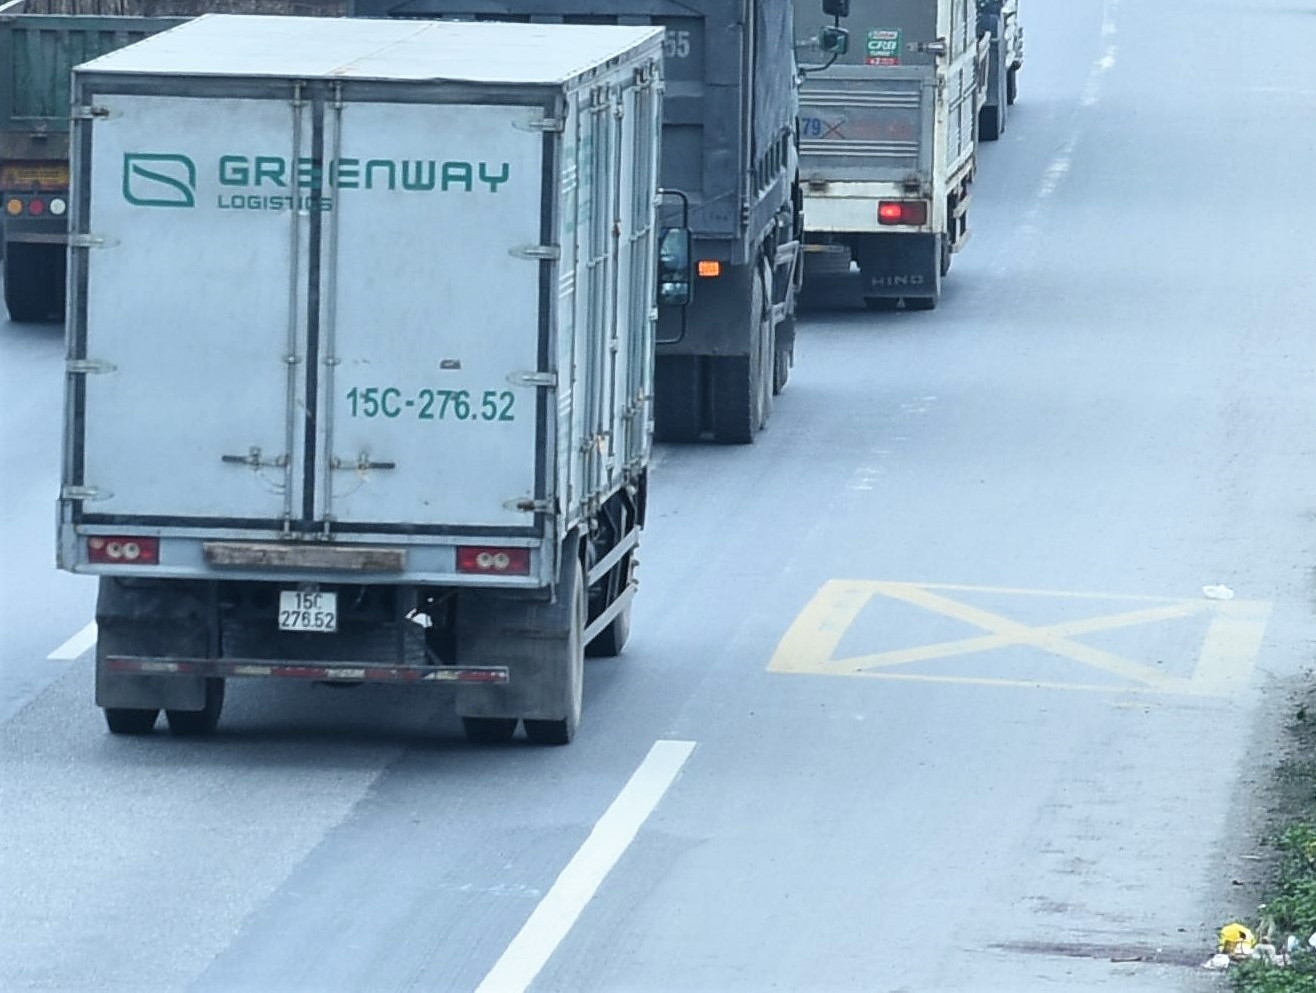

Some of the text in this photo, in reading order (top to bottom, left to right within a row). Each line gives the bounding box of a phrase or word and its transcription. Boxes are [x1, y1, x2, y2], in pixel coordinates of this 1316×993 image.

[218, 155, 510, 193] GREENWAY
[217, 194, 334, 213] LOGISTICS
[871, 274, 924, 287] HINO
[346, 386, 515, 422] 15C-276.52
[296, 592, 323, 610] 15C
